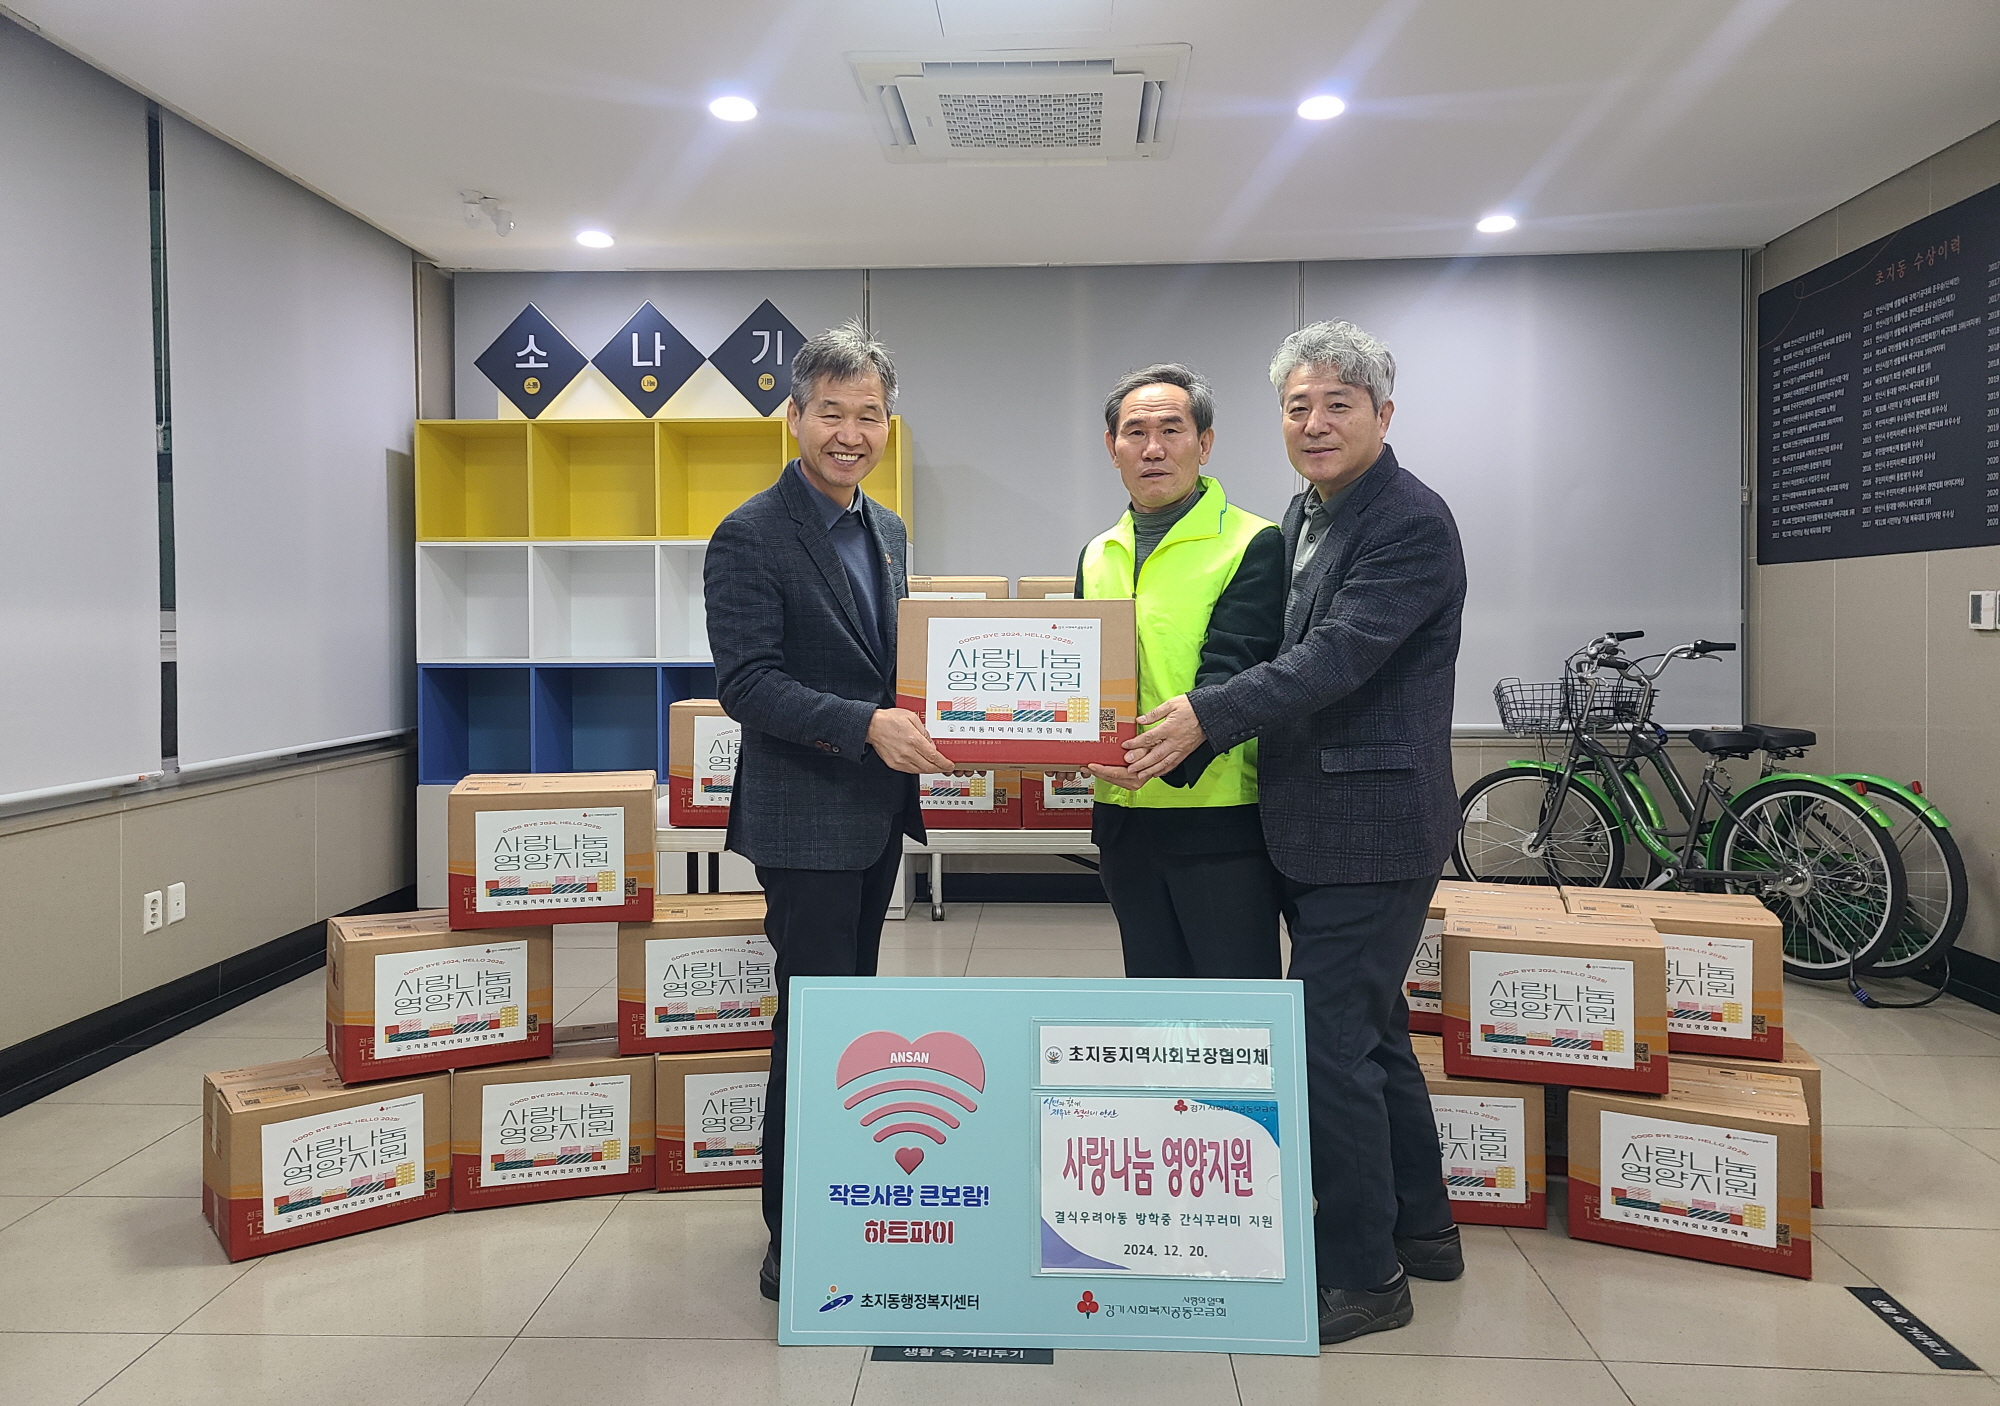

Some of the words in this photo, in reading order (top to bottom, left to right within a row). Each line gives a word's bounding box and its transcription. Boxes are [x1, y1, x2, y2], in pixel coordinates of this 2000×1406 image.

[1875, 260, 1906, 285] 초지동
[1914, 235, 1960, 270] 수상이력
[515, 335, 548, 368] 소
[632, 332, 665, 366] 나
[751, 331, 782, 365] 기
[959, 635, 980, 645] GOOD
[948, 648, 1081, 669] 사랑나눔
[947, 671, 1081, 692] 영양지원
[1608, 779, 1619, 797] BIKE
[494, 834, 608, 853] 사랑나눔
[494, 851, 608, 871] 영양지원
[663, 960, 770, 981] 사랑나눔
[1666, 960, 1734, 980] 나눔
[395, 970, 511, 996] 사랑나눔
[663, 977, 770, 998] 영양지원
[1490, 980, 1614, 1005] 사랑나눔
[1666, 978, 1734, 998] 지원
[395, 986, 510, 1015] 영양지원
[1490, 999, 1616, 1025] 영양지원
[890, 1051, 929, 1064] ANSAN
[1069, 1046, 1268, 1065] 초지동지역사회보장협의체
[500, 1103, 614, 1126] 사랑나눔
[702, 1097, 766, 1115] 사랑
[500, 1120, 614, 1145] 영양지원
[702, 1115, 765, 1133] 영양
[1438, 1123, 1507, 1142] 나눔
[284, 1127, 406, 1166] 사랑나눔
[1440, 1142, 1507, 1162] 지원
[283, 1142, 407, 1186] 영양지원
[1063, 1136, 1154, 1196] 사랑나눔
[1162, 1137, 1253, 1198] 영양지원
[1622, 1142, 1756, 1180] 사랑나눔
[1621, 1162, 1756, 1200] 영양지원
[829, 1184, 914, 1207] 작은사랑
[920, 1184, 989, 1207] 큰보람!
[1055, 1211, 1128, 1225] 결식우려아동
[1136, 1213, 1172, 1226] 방학중
[1180, 1214, 1241, 1227] 간식꾸러미
[1249, 1215, 1273, 1228] 지원
[864, 1220, 954, 1244] 하트파이
[1124, 1244, 1157, 1256] 2024.
[1164, 1245, 1182, 1257] 12.
[1189, 1246, 1208, 1258] 20.
[860, 1293, 980, 1311] 초지동행정복지센터
[1104, 1304, 1125, 1317] 경기
[1127, 1305, 1227, 1319] 사회복지공동모금회
[903, 1348, 934, 1357] 생활
[940, 1348, 956, 1357] 속
[962, 1349, 1024, 1358] 거리두기
